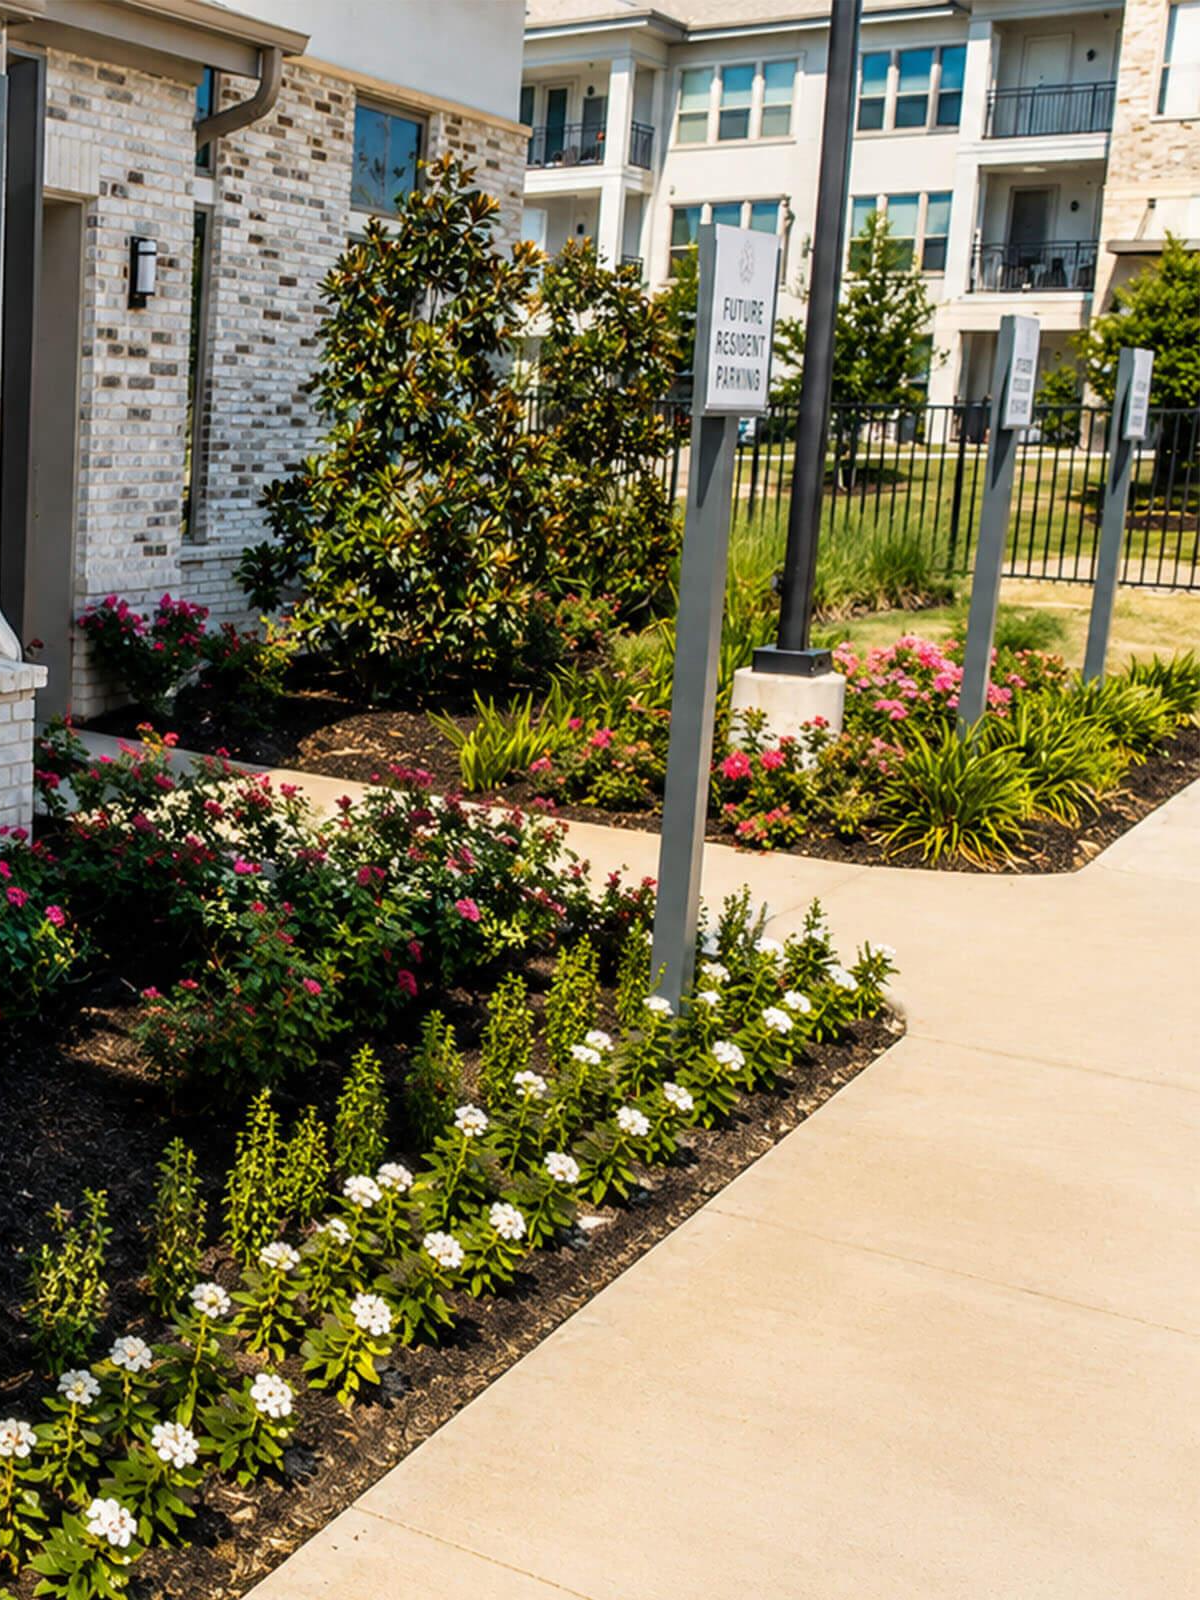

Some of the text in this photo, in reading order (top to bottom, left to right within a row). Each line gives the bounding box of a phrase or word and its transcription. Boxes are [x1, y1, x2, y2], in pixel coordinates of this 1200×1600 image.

[723, 297, 764, 325] FUTURE
[715, 330, 766, 358] RESIDENT
[716, 365, 760, 391] PARKING
